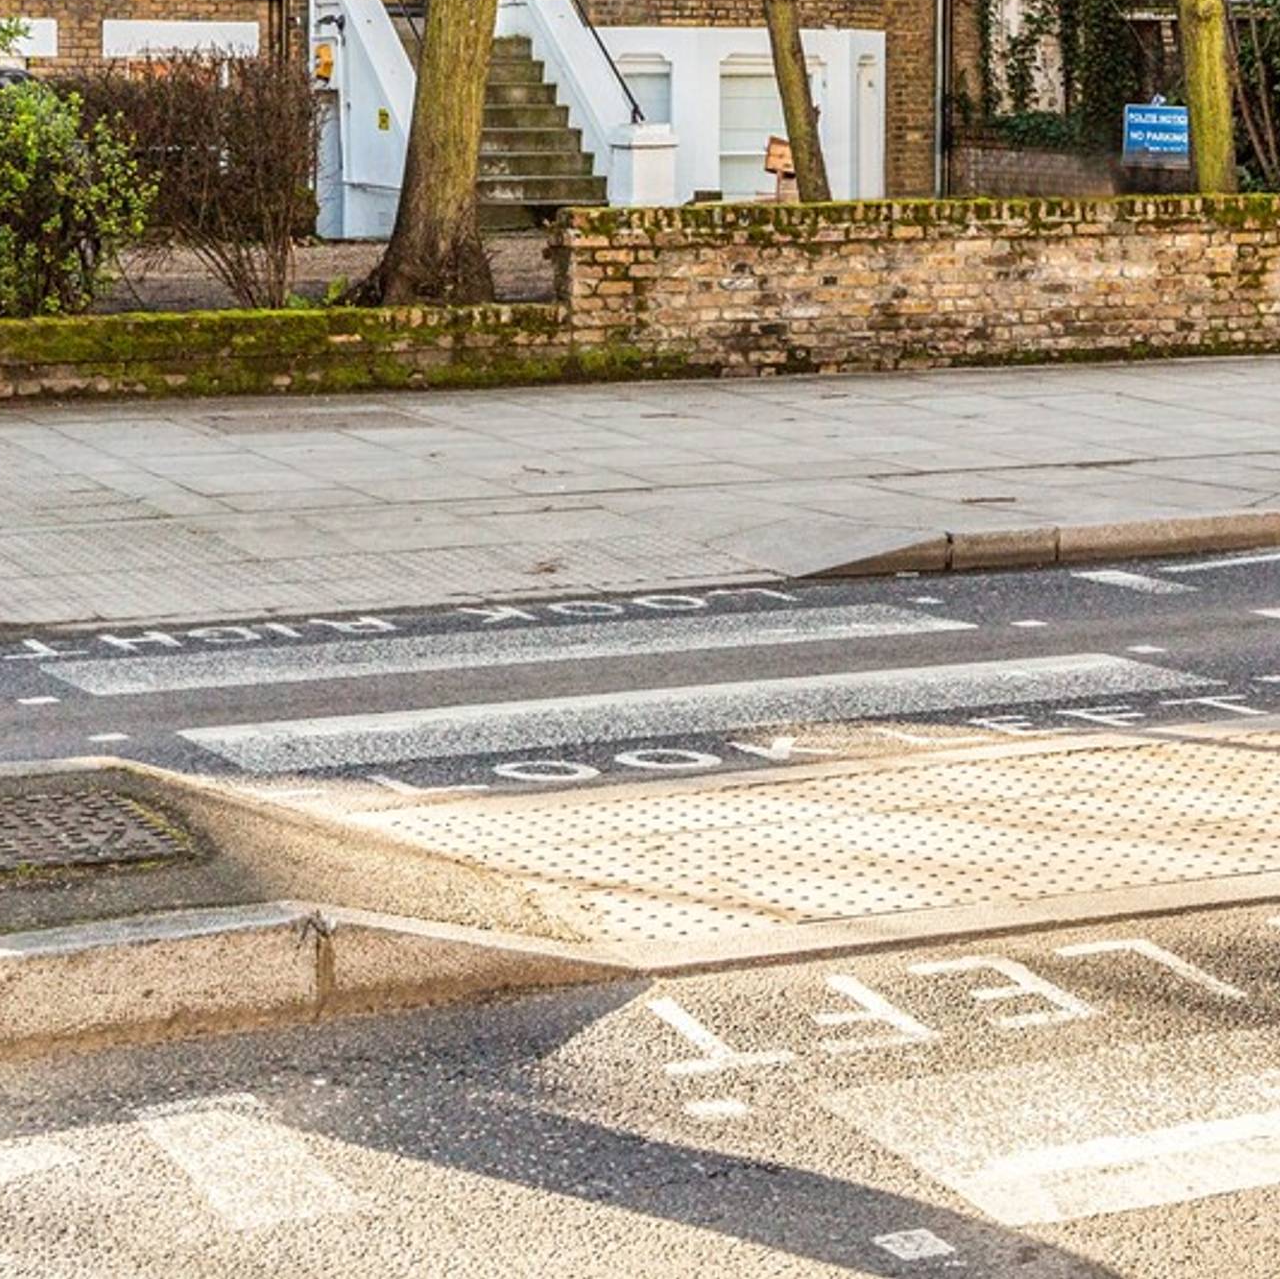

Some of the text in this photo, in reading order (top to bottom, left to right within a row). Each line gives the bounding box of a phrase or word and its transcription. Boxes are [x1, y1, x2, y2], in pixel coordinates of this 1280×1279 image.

[1130, 131, 1145, 141] NO
[4, 588, 799, 659] LOOK RIGHT
[368, 694, 1265, 795] LOOK LEFT
[646, 937, 1249, 1075] LEFT
